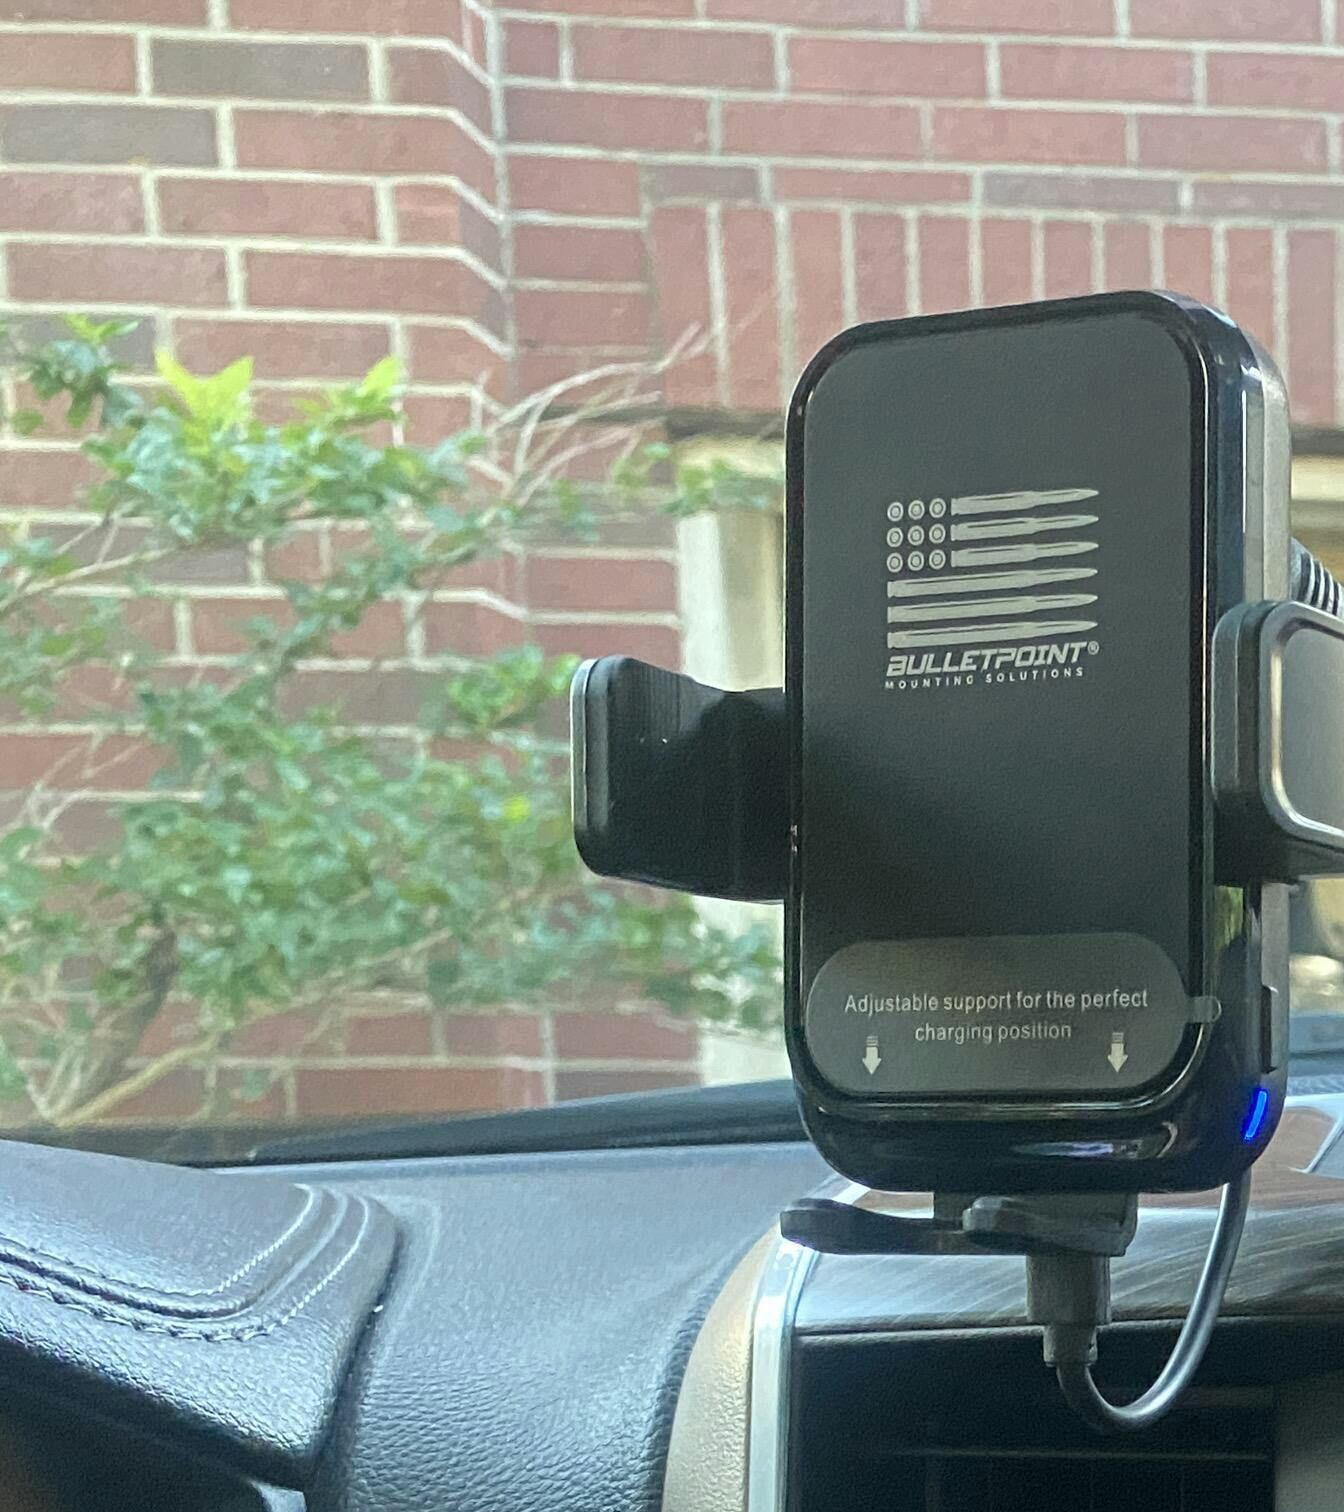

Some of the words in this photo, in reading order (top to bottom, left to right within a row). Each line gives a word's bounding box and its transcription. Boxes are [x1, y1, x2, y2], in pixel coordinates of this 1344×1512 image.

[884, 674, 975, 690] MOUNTING
[985, 666, 1085, 683] SOLUTIONS
[844, 993, 938, 1017] Adjustable
[943, 992, 1012, 1013] support
[1016, 990, 1042, 1009] for
[1046, 990, 1076, 1009] the
[1080, 988, 1149, 1011] perfect
[914, 1023, 993, 1046] charging
[997, 1022, 1073, 1043] position
